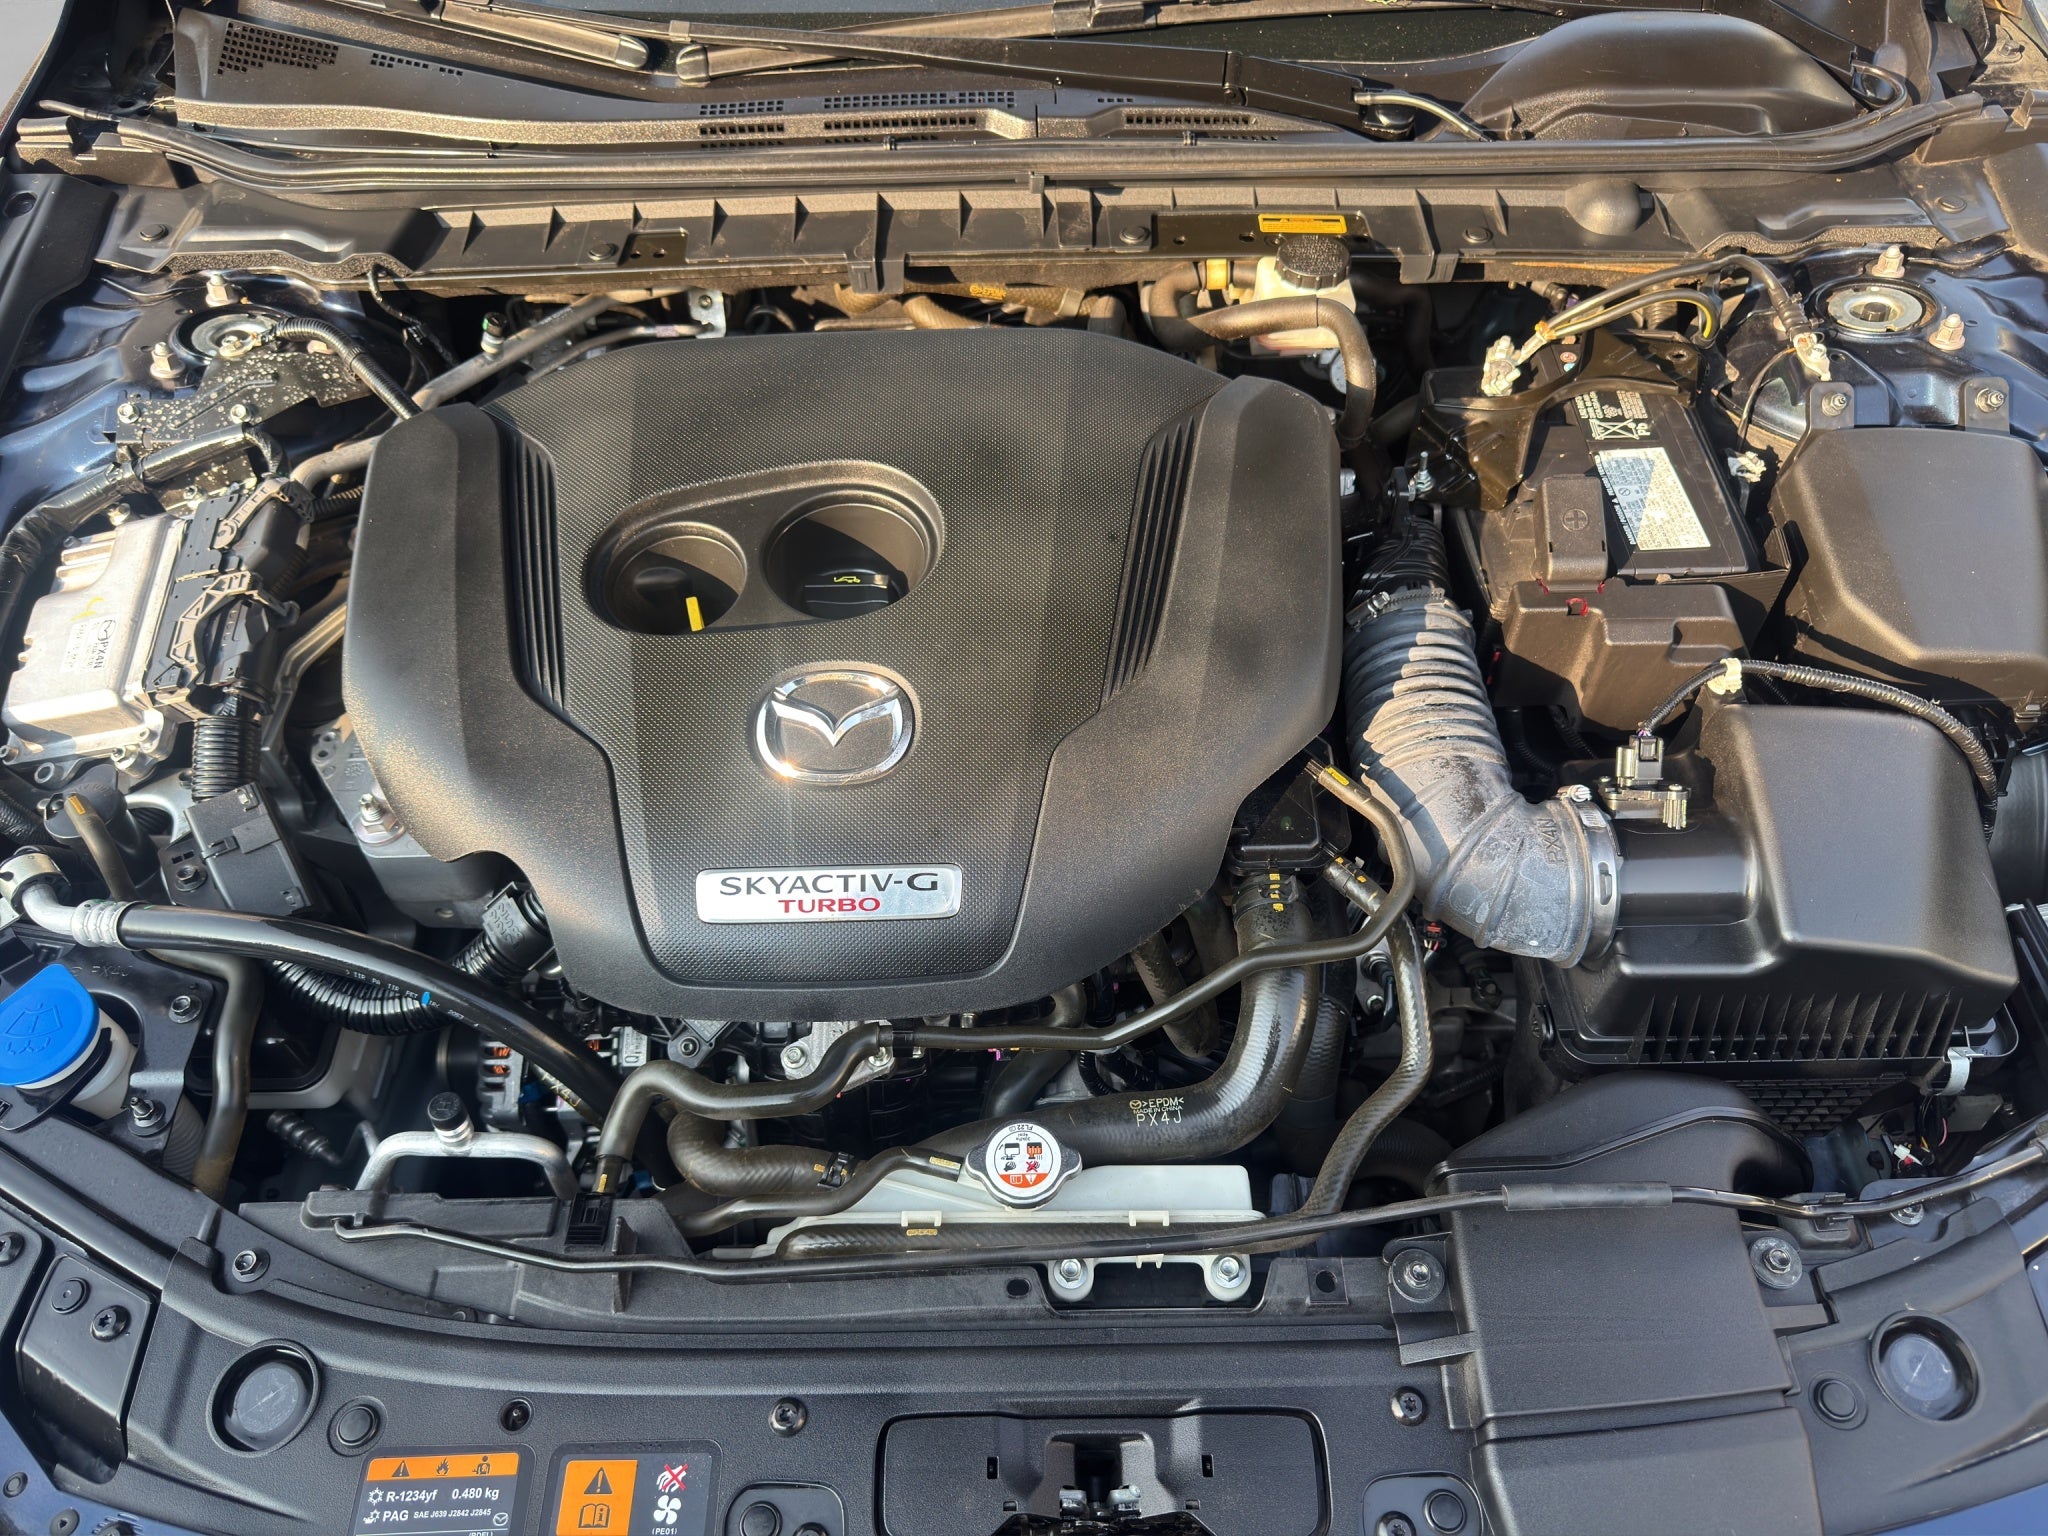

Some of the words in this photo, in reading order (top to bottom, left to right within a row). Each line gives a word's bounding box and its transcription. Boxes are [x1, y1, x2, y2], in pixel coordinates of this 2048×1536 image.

[719, 873, 939, 896] SKYACTIV-G
[778, 897, 881, 914] TURBO
[386, 1489, 438, 1503] R-1234yf
[452, 1488, 482, 1500] 0.480
[485, 1487, 500, 1501] kg
[382, 1510, 409, 1522] PAG
[413, 1511, 429, 1519] SAE
[430, 1510, 448, 1518] J639
[448, 1509, 469, 1517] J2842
[470, 1508, 492, 1517] J2845
[652, 1527, 678, 1535] (PE01)
